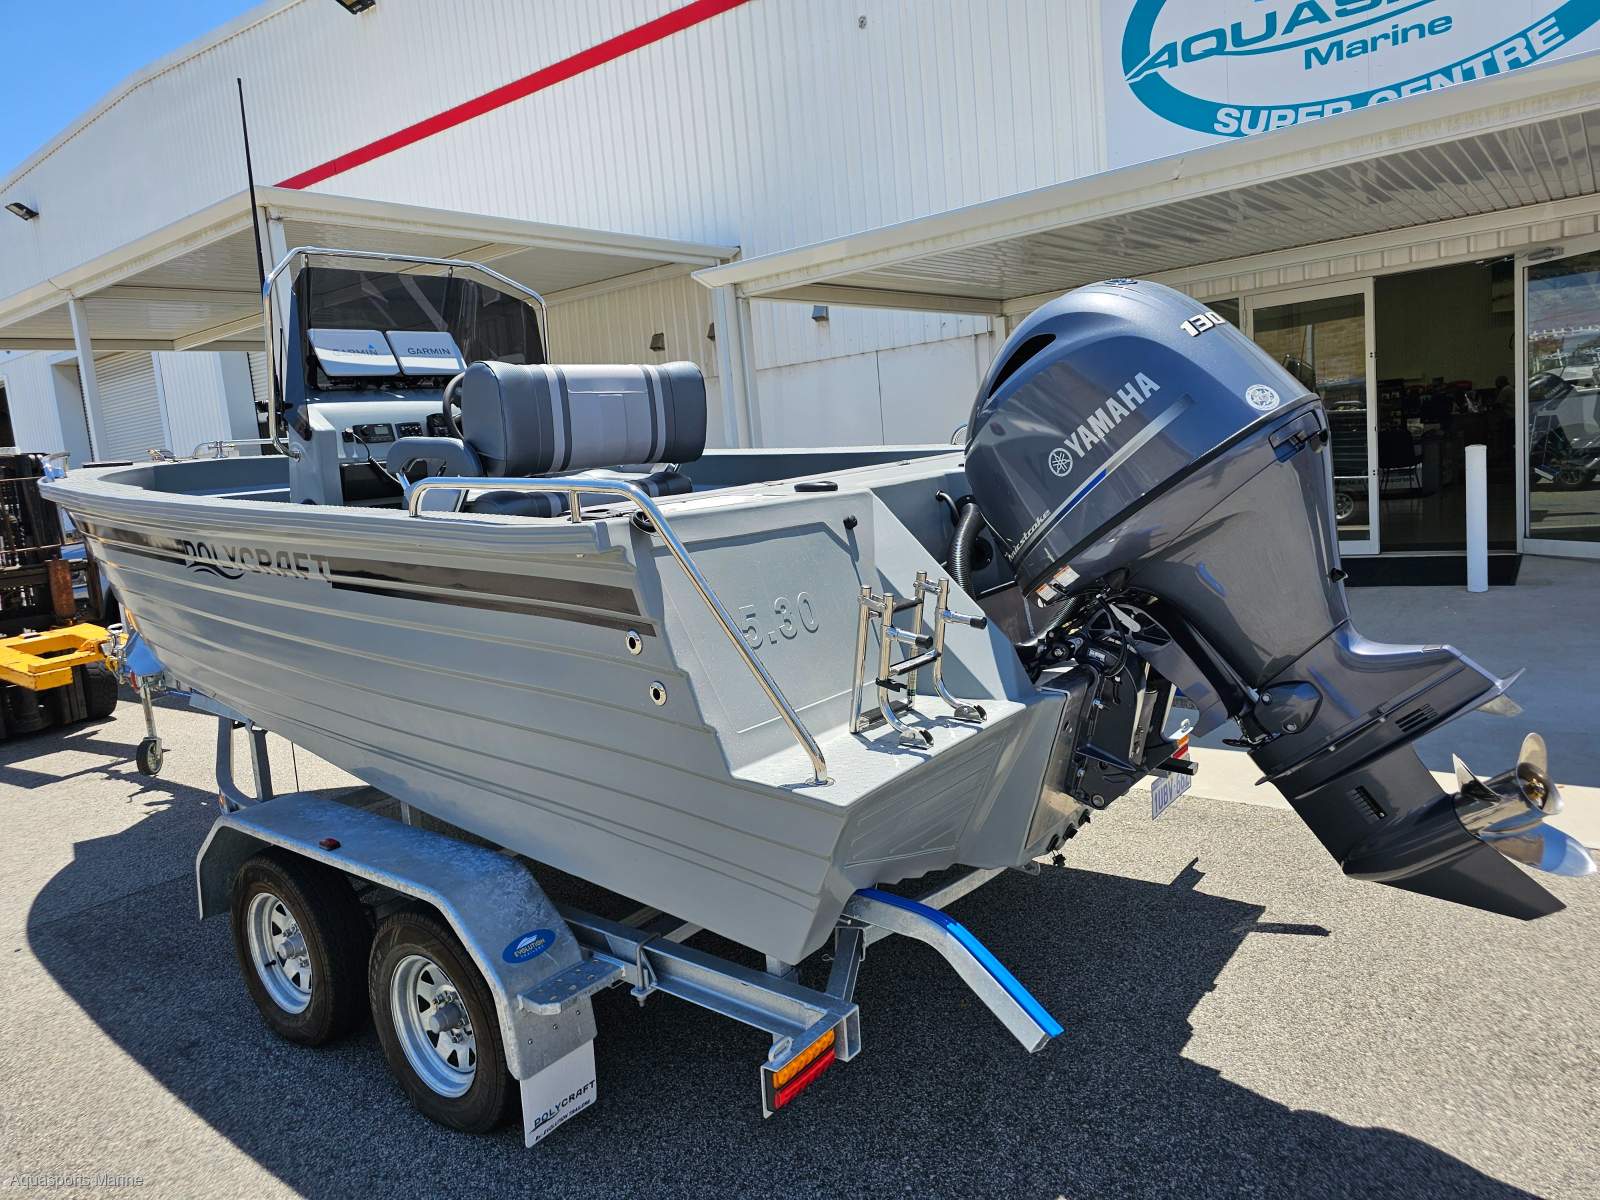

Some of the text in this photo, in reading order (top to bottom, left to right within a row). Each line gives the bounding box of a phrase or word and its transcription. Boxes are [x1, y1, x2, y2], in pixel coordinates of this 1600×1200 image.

[1304, 15, 1453, 70] Marine
[1180, 311, 1226, 337] 130
[407, 347, 451, 355] GARMIN
[1063, 371, 1161, 458] YAMAHA
[738, 591, 819, 650] 5.30
[533, 1079, 596, 1129] POLYCRAFT
